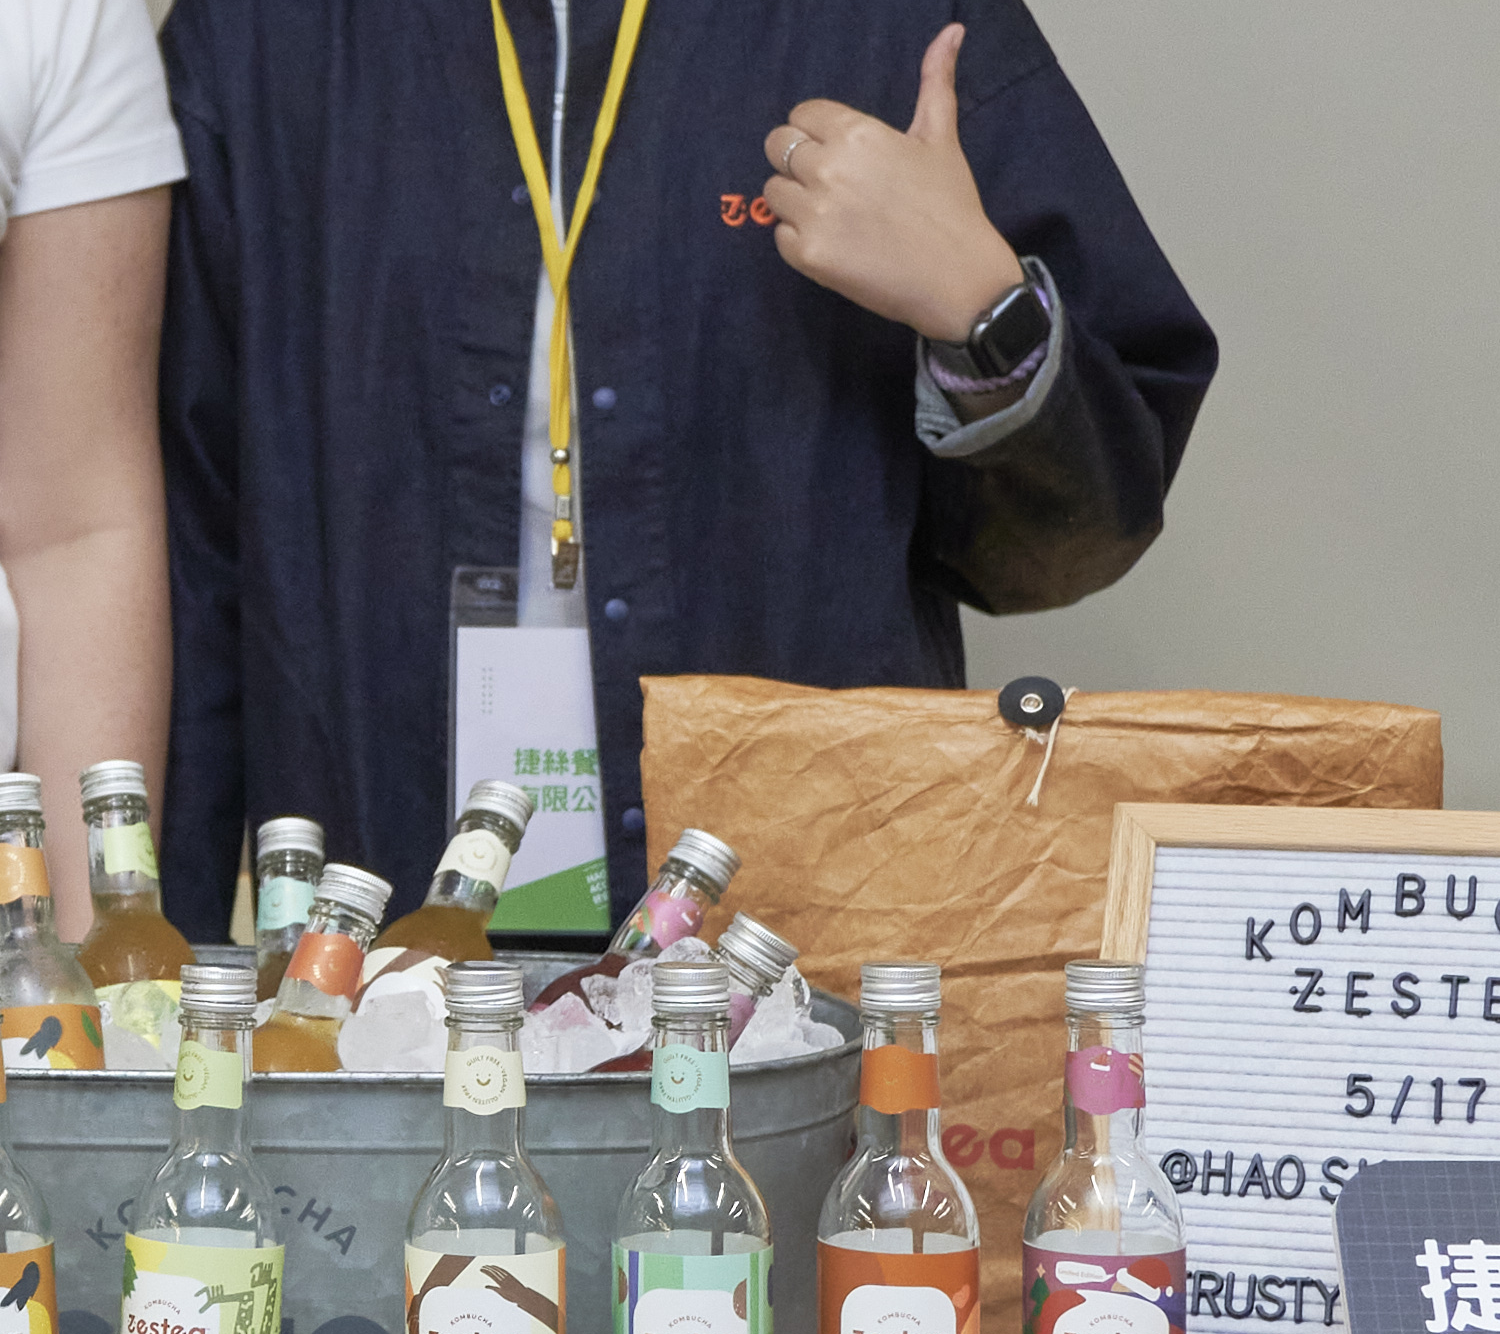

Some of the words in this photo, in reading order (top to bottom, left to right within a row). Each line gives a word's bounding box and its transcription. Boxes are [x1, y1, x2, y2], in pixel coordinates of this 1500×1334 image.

[1344, 1073, 1488, 1125] 5/17
[144, 1299, 181, 1315] KOMBUCHA
[450, 1313, 493, 1328] KOMBUCHA
[668, 1316, 712, 1329] KOMBUCHA
[877, 1311, 921, 1326] KOMBUCHA
[1089, 1314, 1134, 1327] KOMBUCHA
